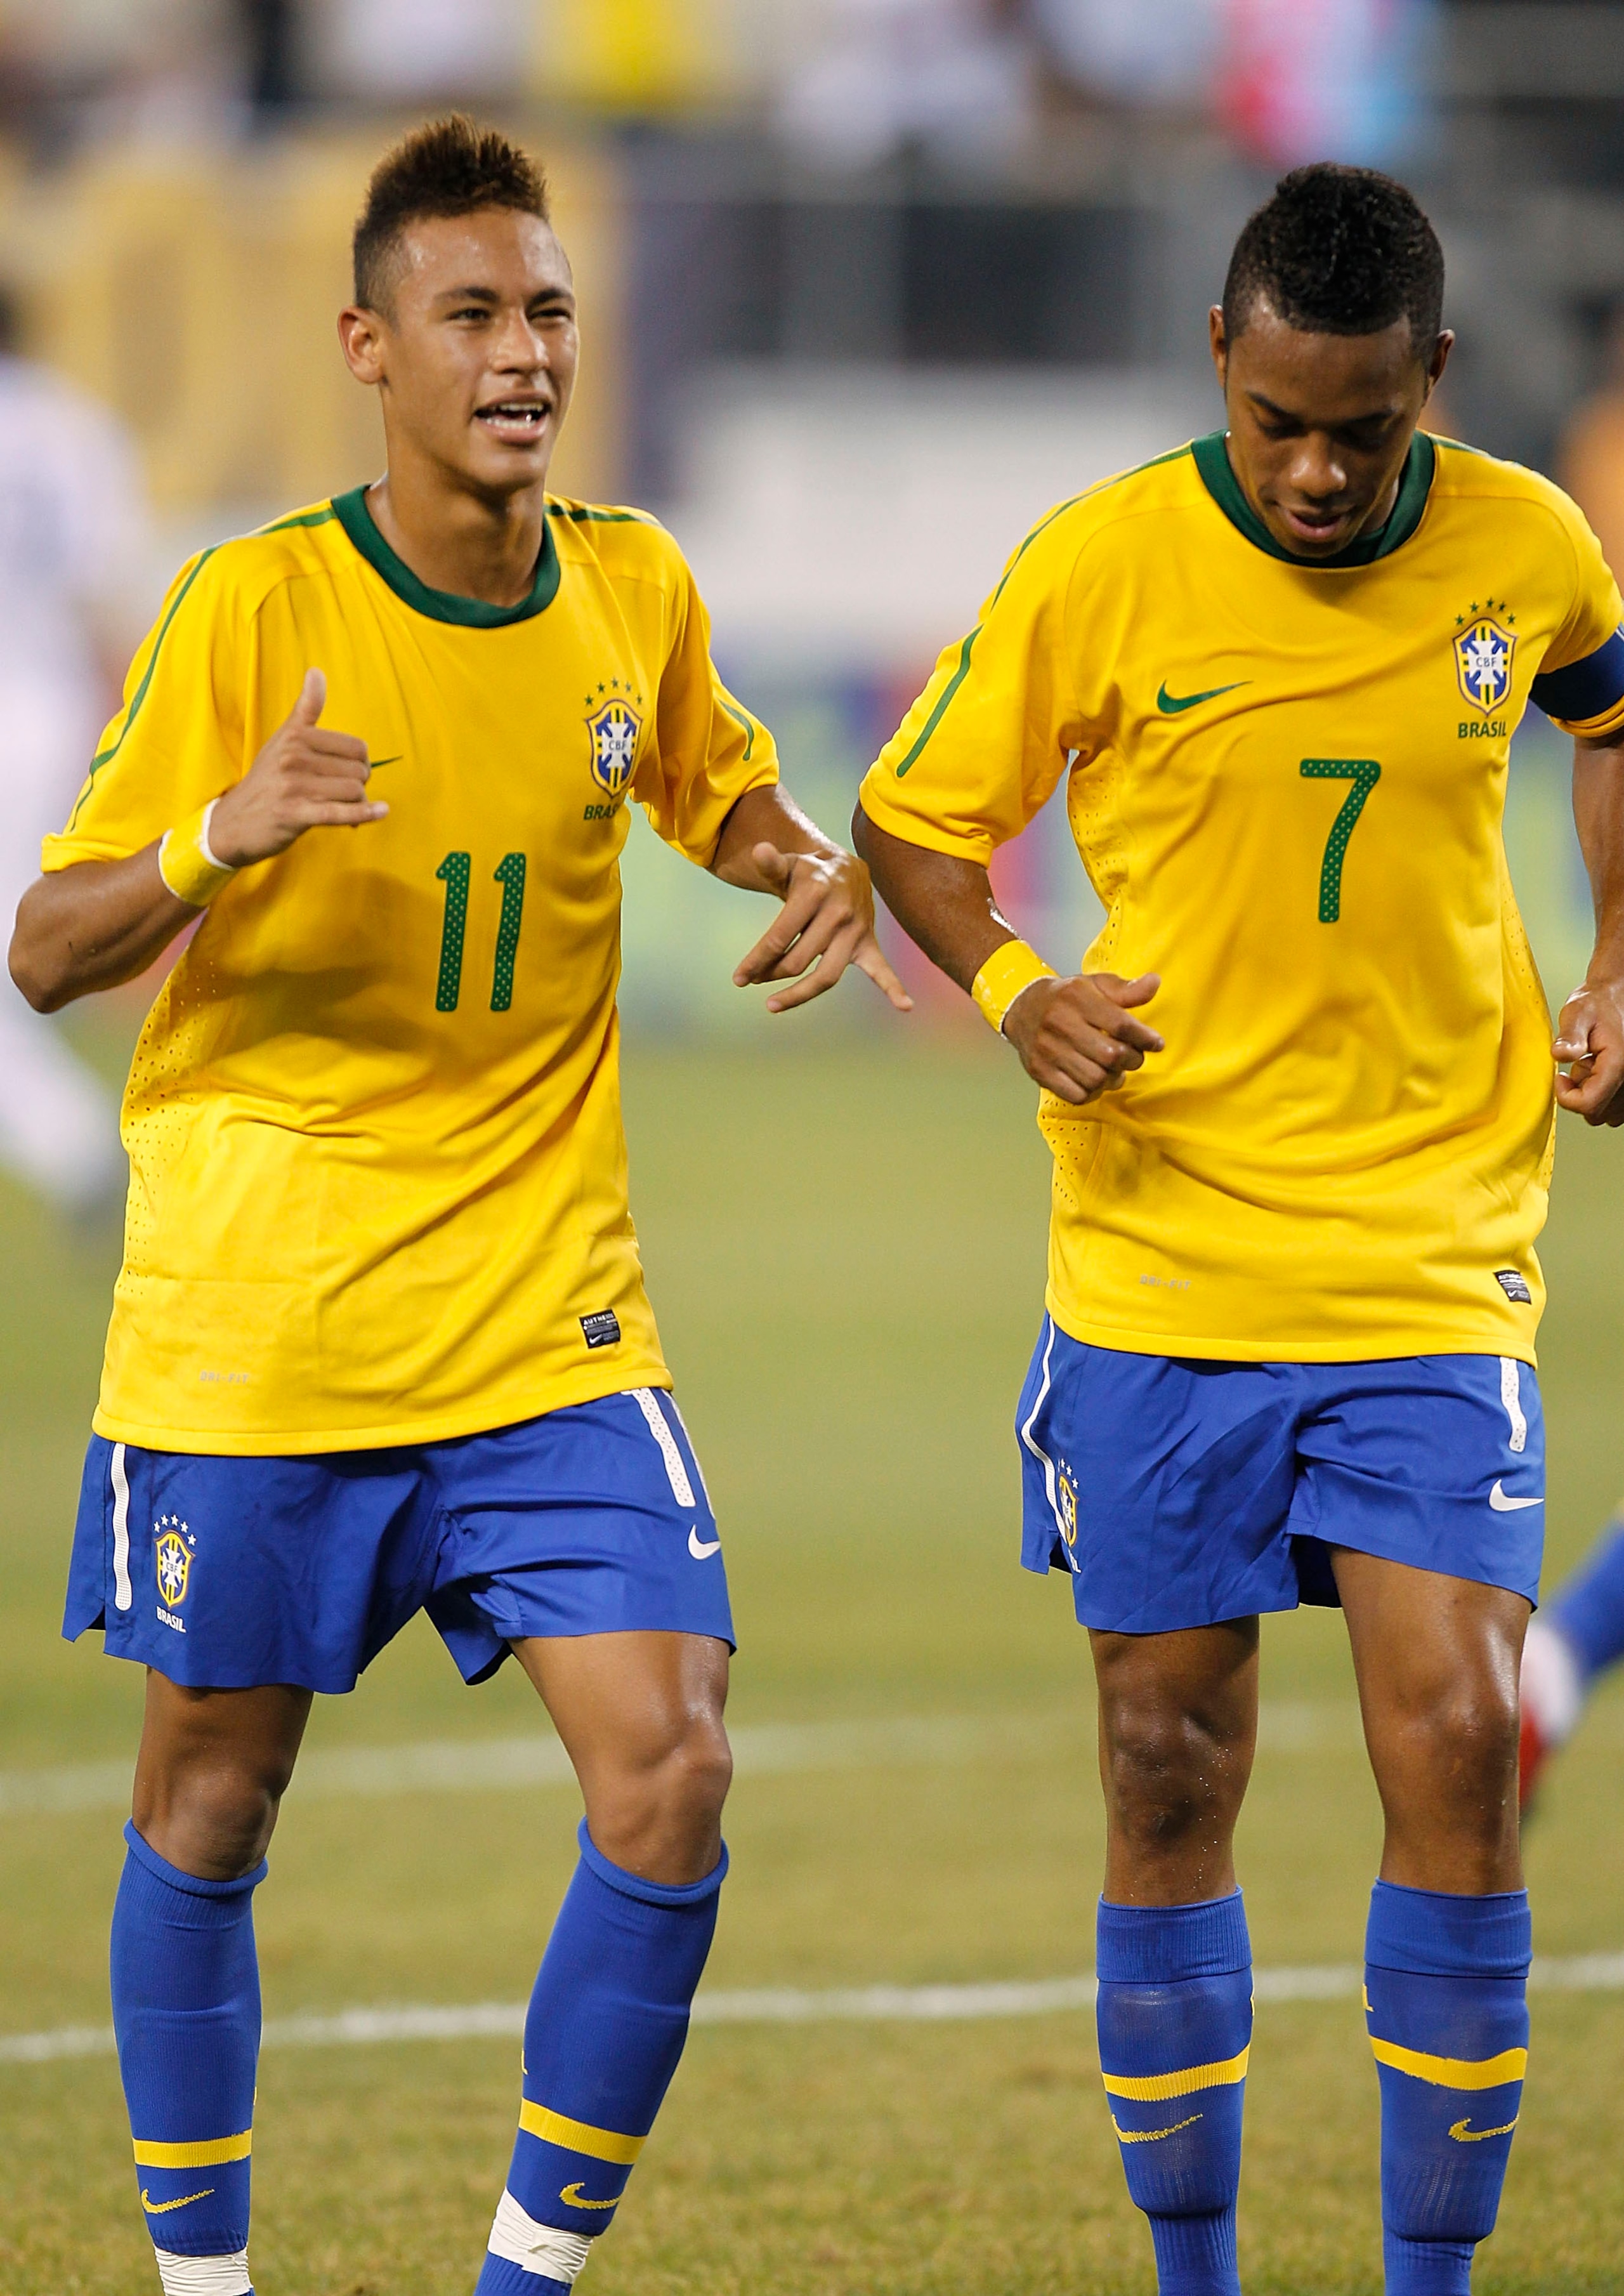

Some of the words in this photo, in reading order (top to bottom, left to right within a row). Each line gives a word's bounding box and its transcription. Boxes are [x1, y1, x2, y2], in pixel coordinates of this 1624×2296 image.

[1475, 656, 1498, 667] CBF
[1457, 721, 1507, 739] BRASIL
[608, 739, 627, 751] CBF
[1299, 758, 1381, 923] 7
[435, 851, 527, 1012] 11
[166, 1561, 178, 1573] CBF
[156, 1605, 187, 1634] BRASIL
